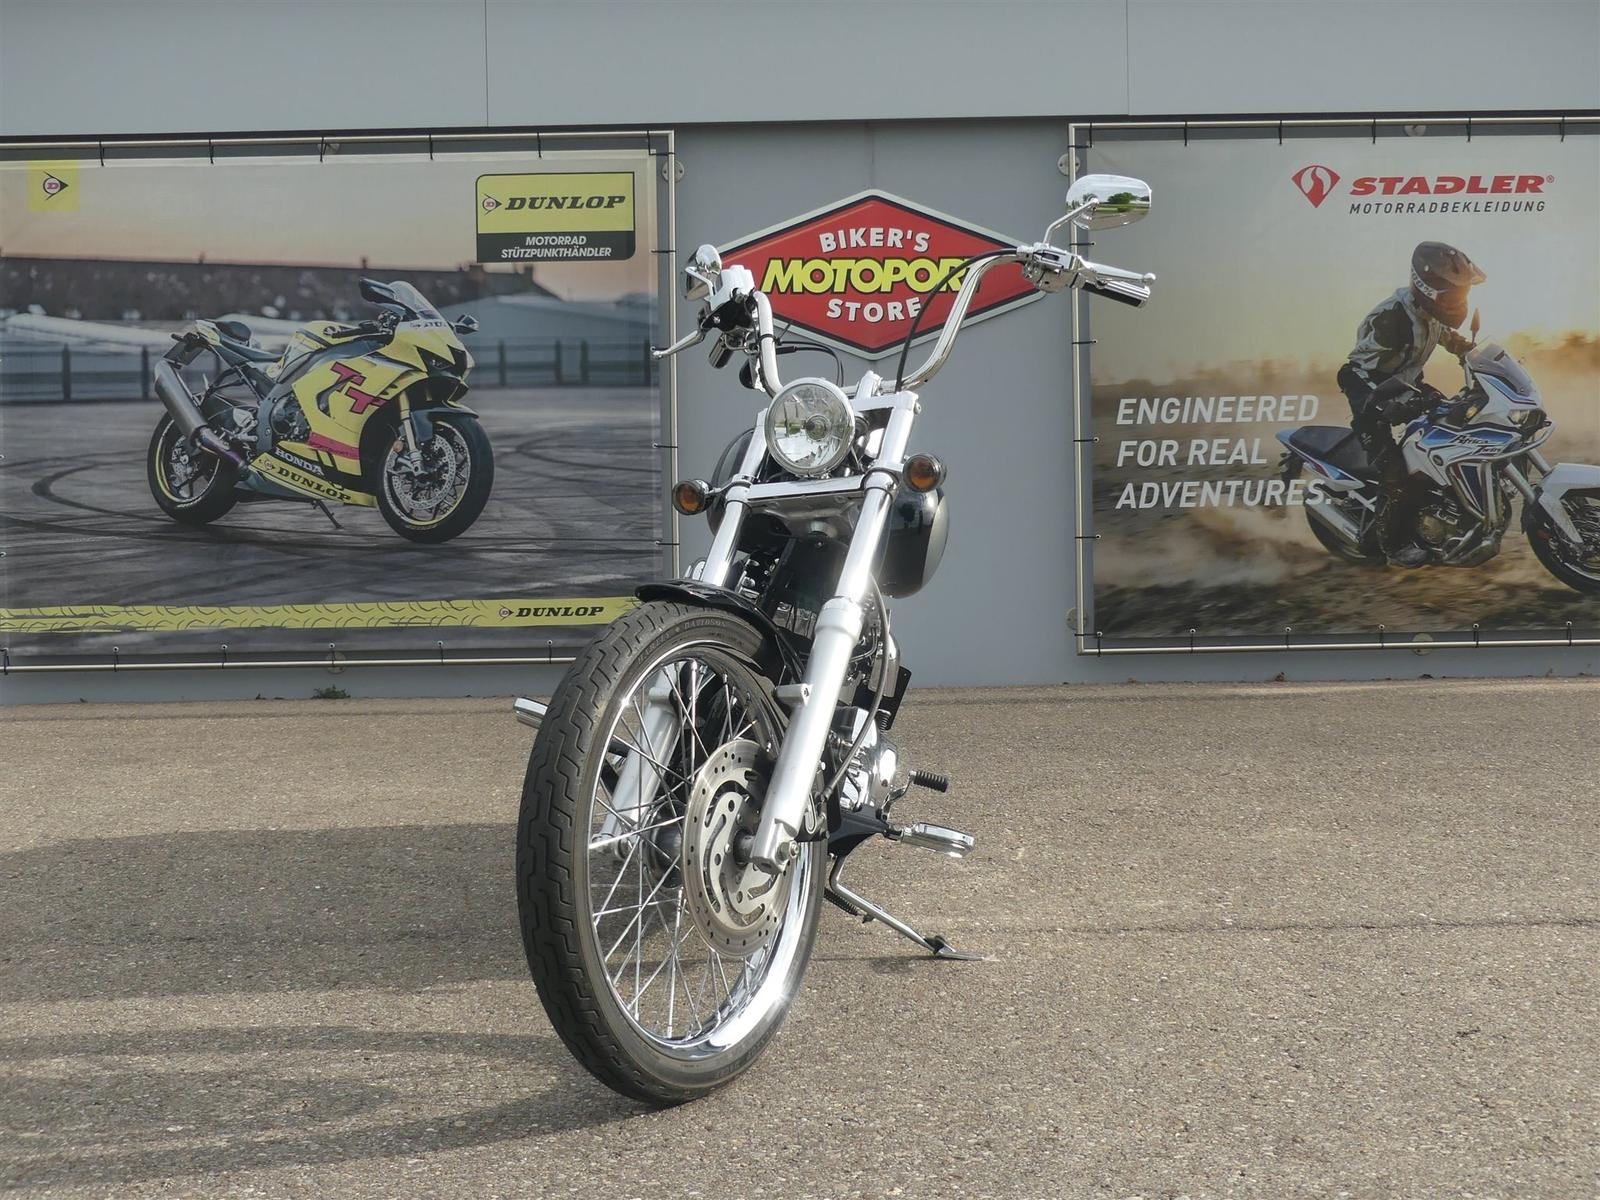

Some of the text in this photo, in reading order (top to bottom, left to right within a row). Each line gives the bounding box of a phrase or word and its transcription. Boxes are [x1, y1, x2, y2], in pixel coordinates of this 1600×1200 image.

[504, 195, 626, 211] DUNLOP
[1349, 201, 1546, 215] MOTORRADBEKLEIDUNG
[501, 245, 612, 259] STÜTZPUNKTHÄNDLER
[525, 235, 587, 246] MOTORRAD
[819, 227, 931, 253] BIKER'S
[761, 257, 975, 294] MOTOPOR
[826, 297, 923, 323] STORE
[1116, 395, 1319, 425] ENGINEERED
[274, 447, 325, 477] HONDA
[1117, 438, 1268, 467] FOR REAL
[277, 466, 352, 501] DUNLOP
[1115, 478, 1332, 510] ADVENTURES.
[516, 606, 604, 618] DUNLOP
